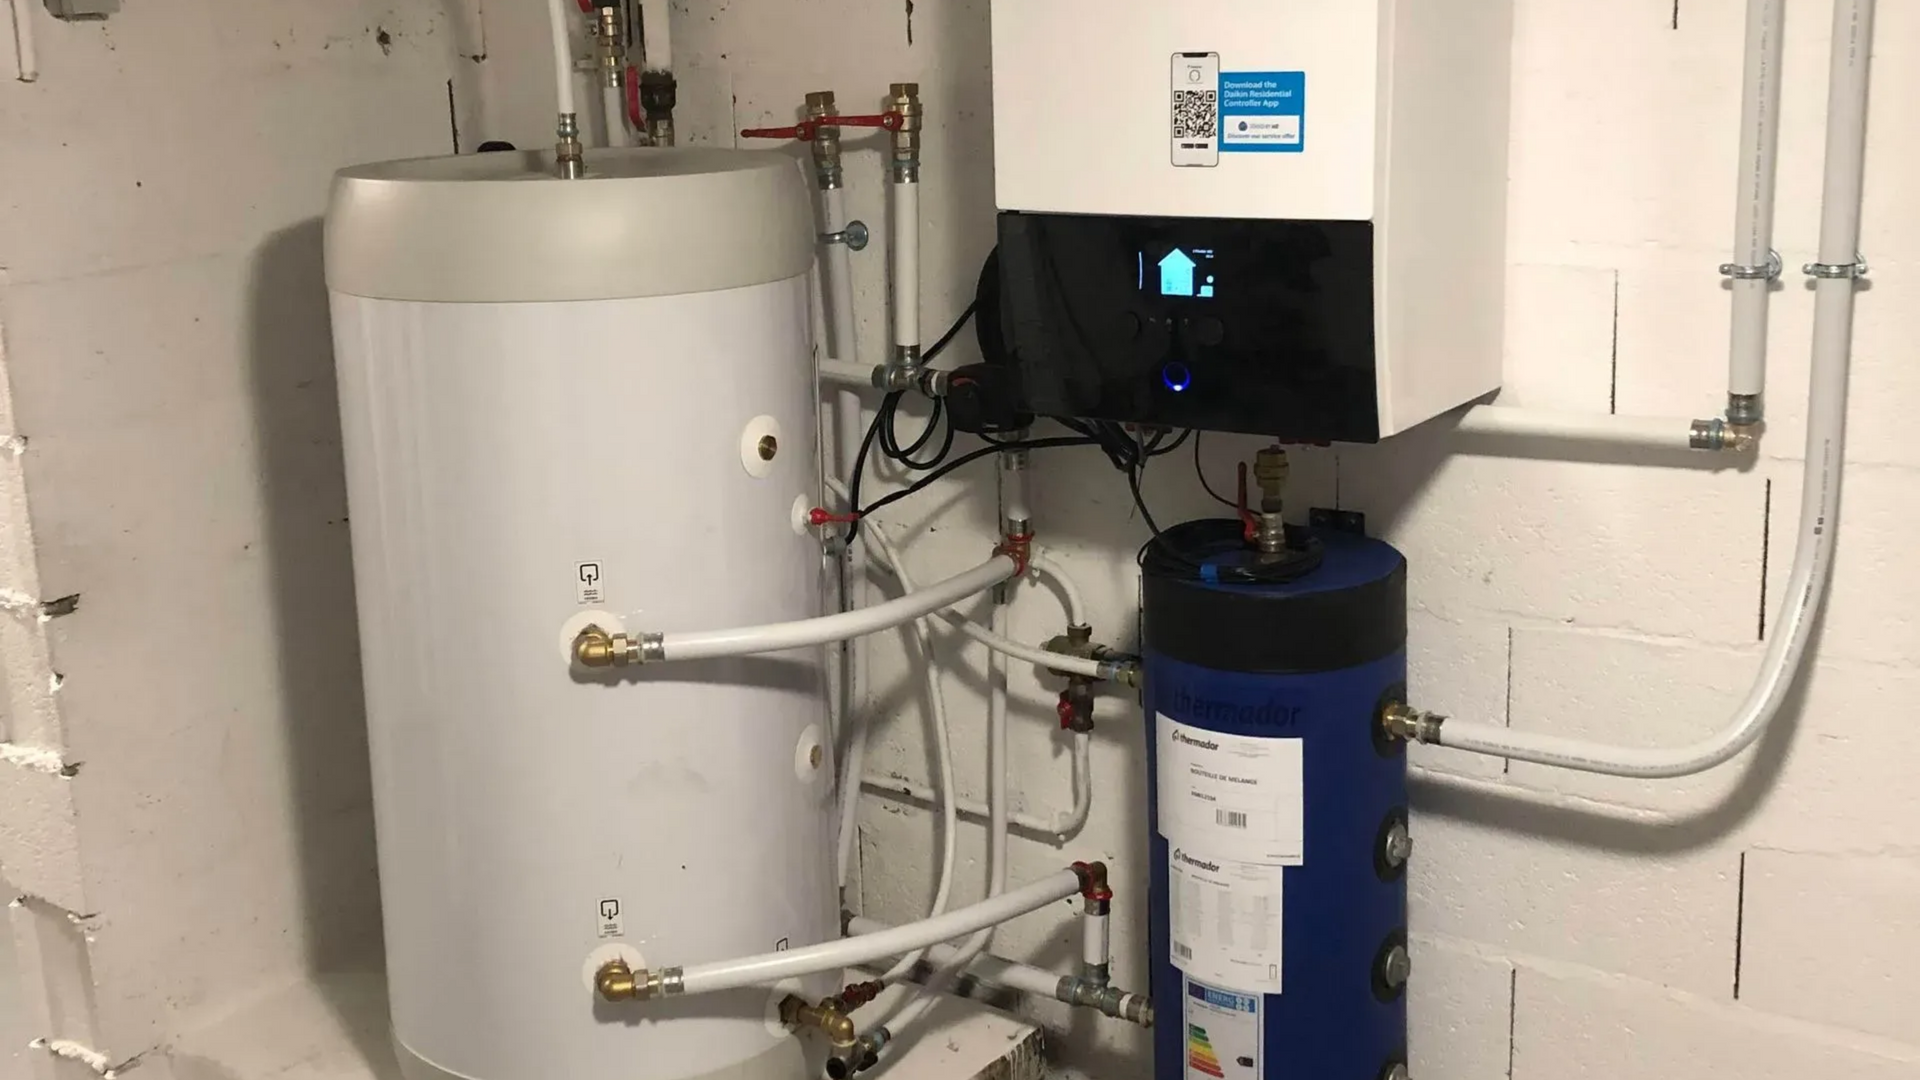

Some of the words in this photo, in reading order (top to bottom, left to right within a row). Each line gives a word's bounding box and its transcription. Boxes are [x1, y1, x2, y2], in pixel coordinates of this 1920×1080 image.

[1223, 81, 1262, 89] Download
[1263, 80, 1277, 88] the
[1223, 90, 1249, 98] Daikin
[1249, 89, 1292, 98] Residential
[1223, 99, 1261, 107] Controller
[1262, 99, 1279, 108] App
[1173, 687, 1302, 727] thermador
[1180, 733, 1219, 751] thermador
[1181, 853, 1220, 873] thermador
